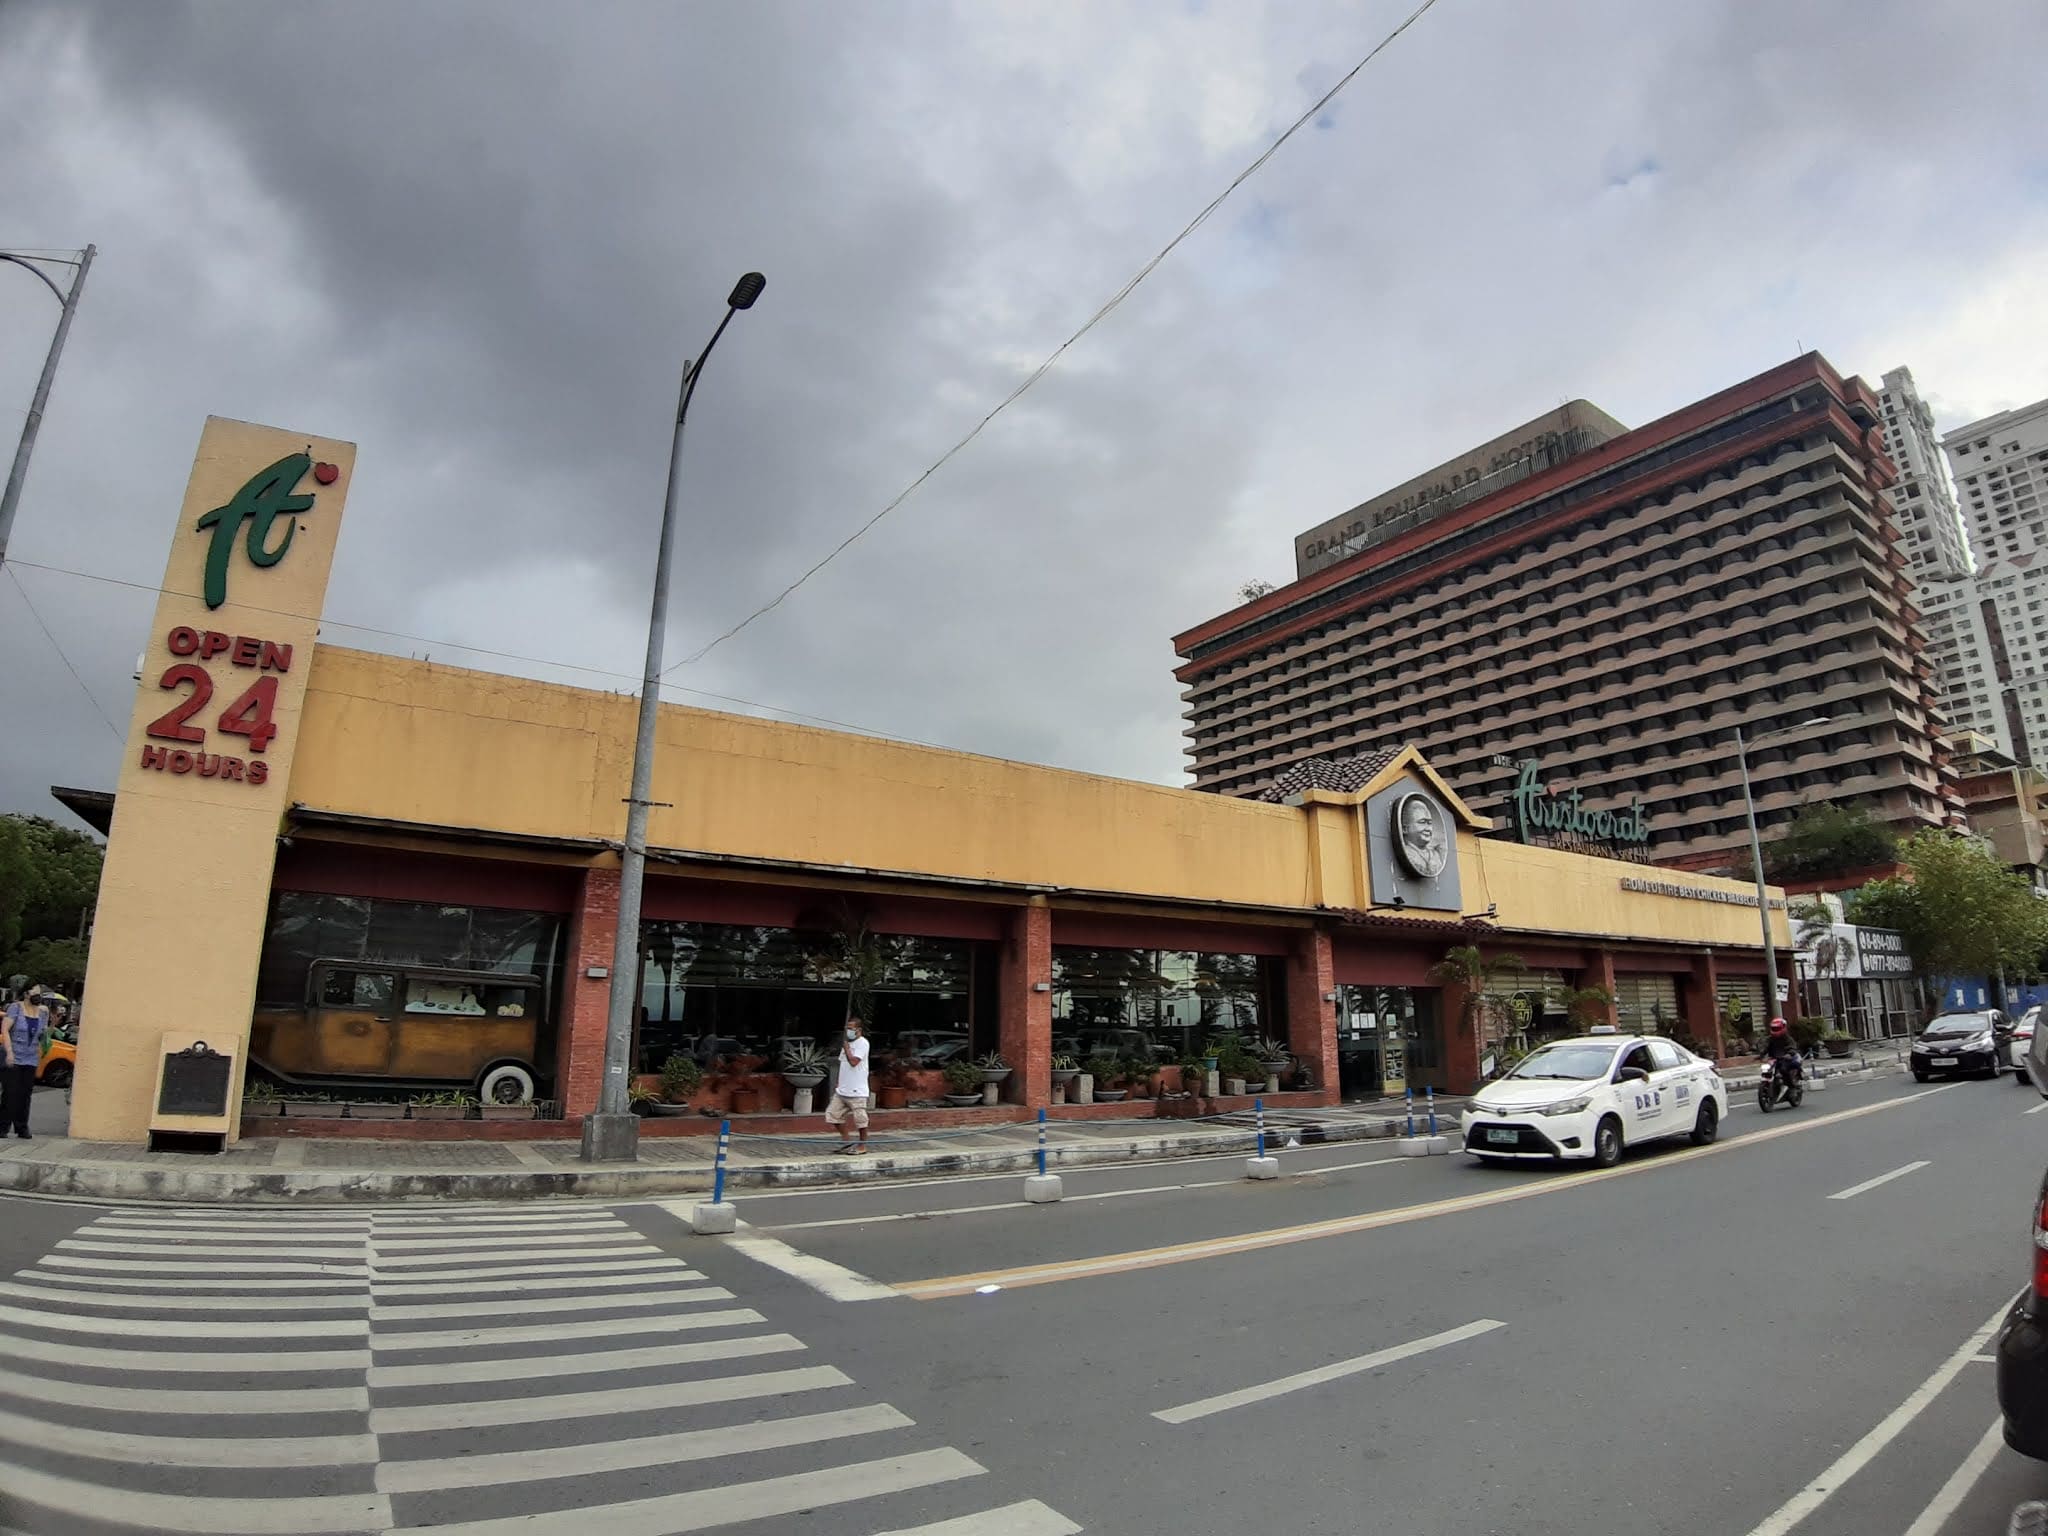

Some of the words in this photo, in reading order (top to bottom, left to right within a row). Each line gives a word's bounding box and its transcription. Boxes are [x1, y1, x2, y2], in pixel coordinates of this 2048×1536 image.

[1306, 521, 1366, 559] GRAND
[167, 626, 293, 672] OPEN
[146, 663, 279, 753] 24
[141, 744, 268, 785] HOURS
[1513, 758, 1650, 845] Aristocrat
[1555, 838, 1612, 861] RESTAURANT
[1625, 878, 1651, 893] HOME
[1663, 882, 1679, 896] THE
[1679, 885, 1697, 898] BEST
[1698, 888, 1727, 902] CHICKEN
